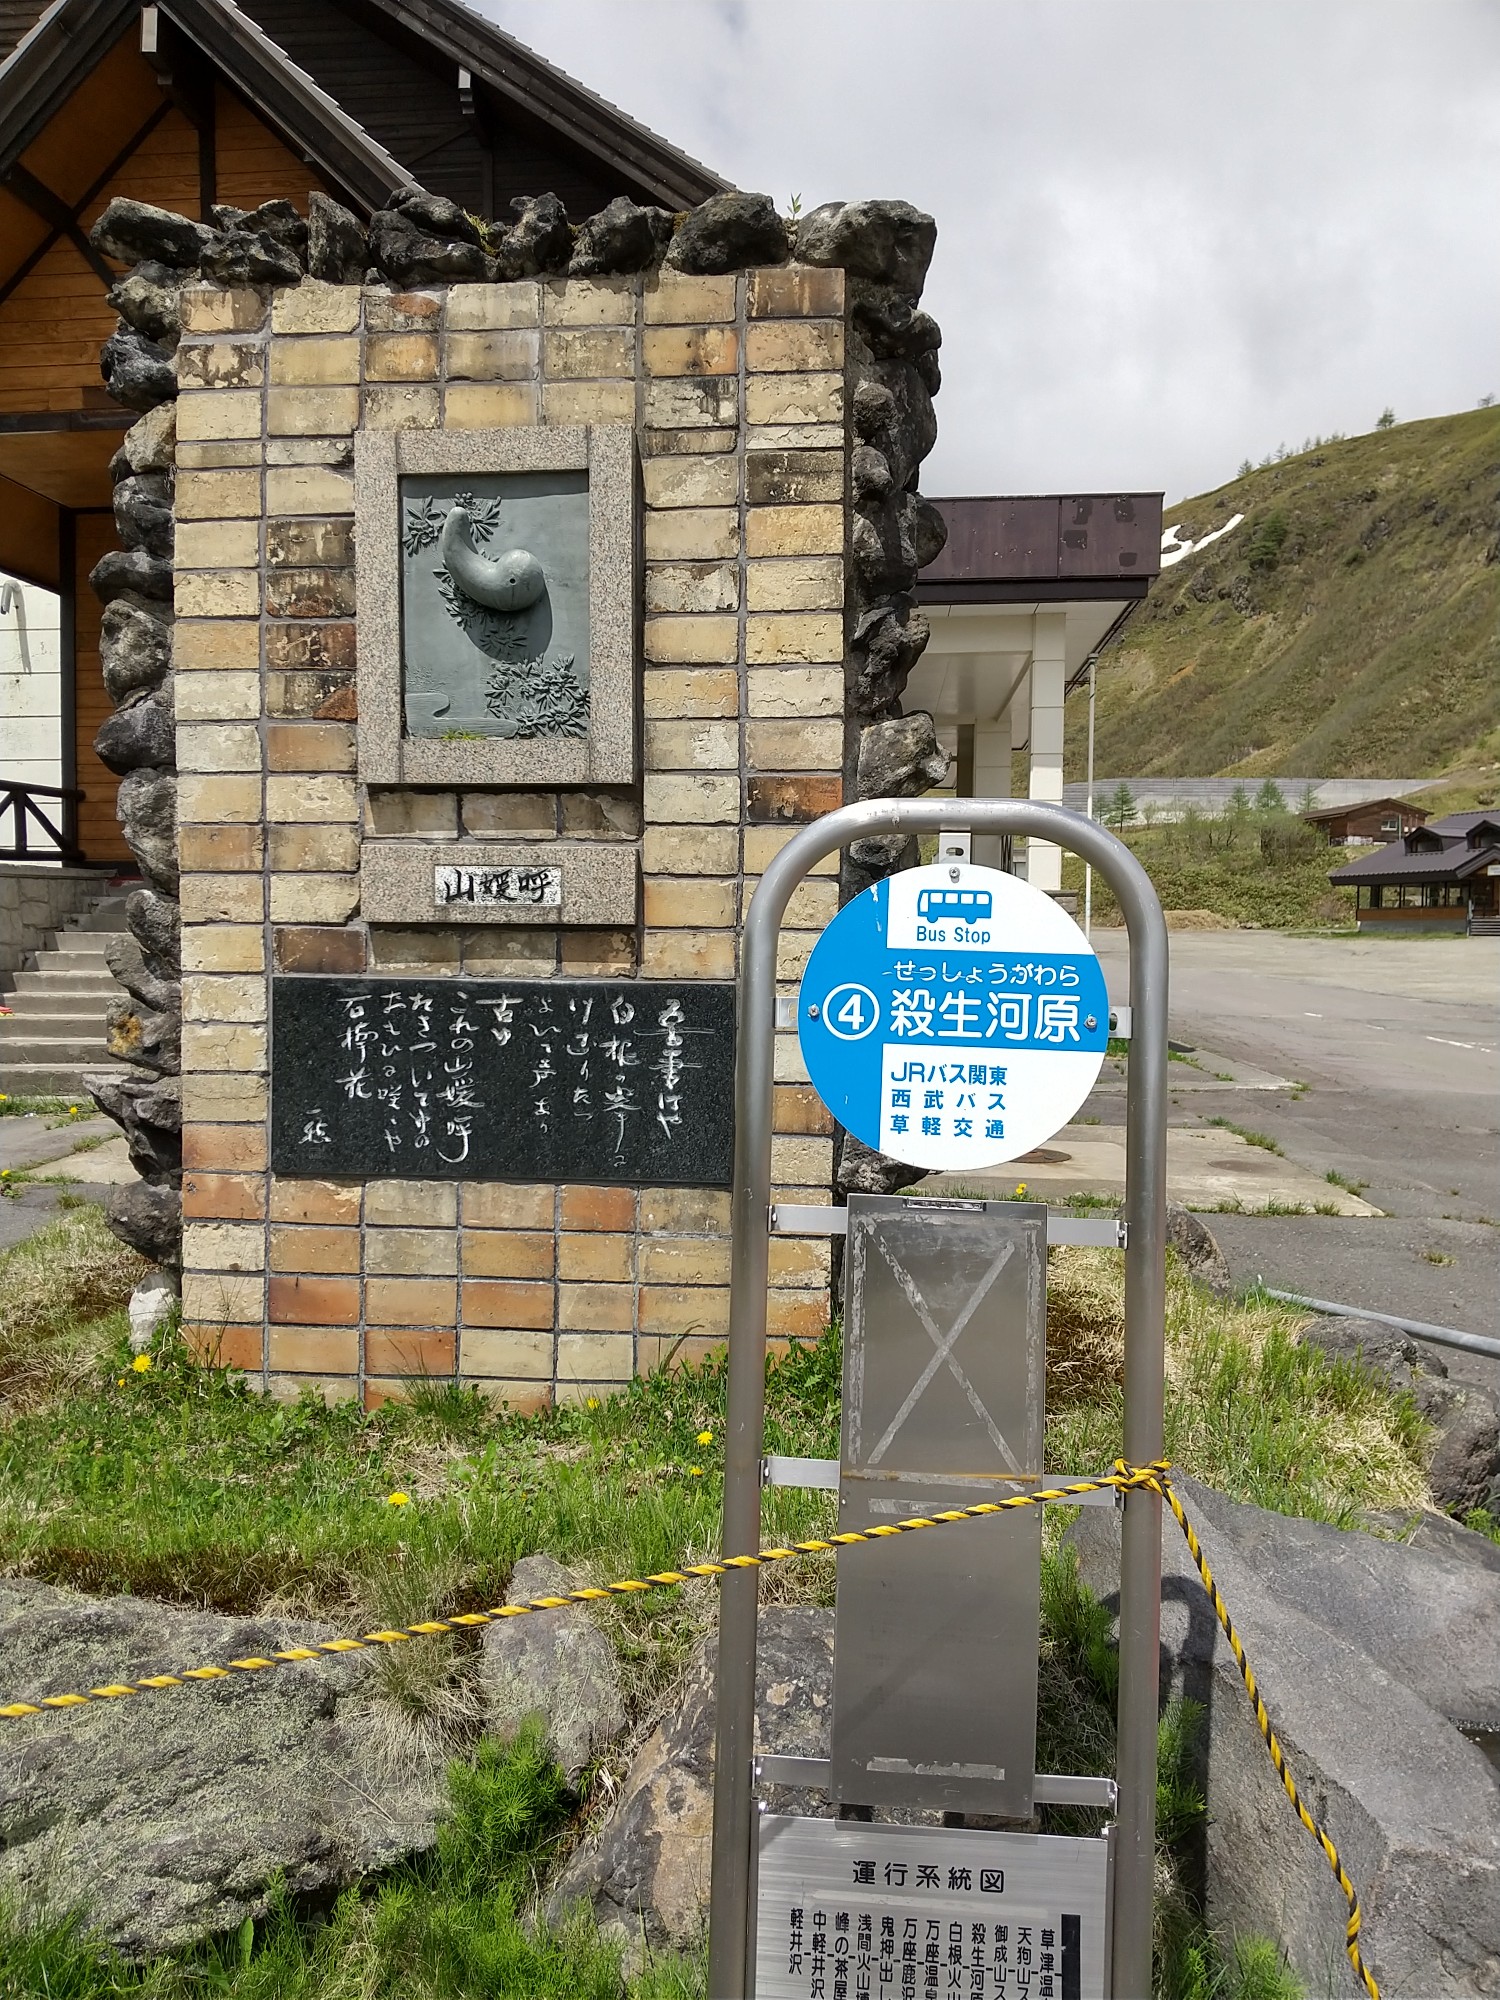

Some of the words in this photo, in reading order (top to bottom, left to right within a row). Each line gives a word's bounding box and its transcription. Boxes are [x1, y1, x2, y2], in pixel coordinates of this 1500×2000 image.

[916, 926, 946, 942] Bus
[953, 927, 991, 944] Stop
[893, 960, 1080, 987] せっしょうがわら
[889, 988, 1082, 1043] 殺生河原
[890, 1061, 1008, 1086] JRバス関東
[891, 1088, 1007, 1111] 西武バス
[889, 1114, 1006, 1139] 草軽交通
[852, 1860, 1005, 1894] 運行系統図
[788, 1907, 804, 1976] 軽井沢
[810, 1910, 827, 2000] 中軽井沢
[1038, 1928, 1056, 2000] 草津温
